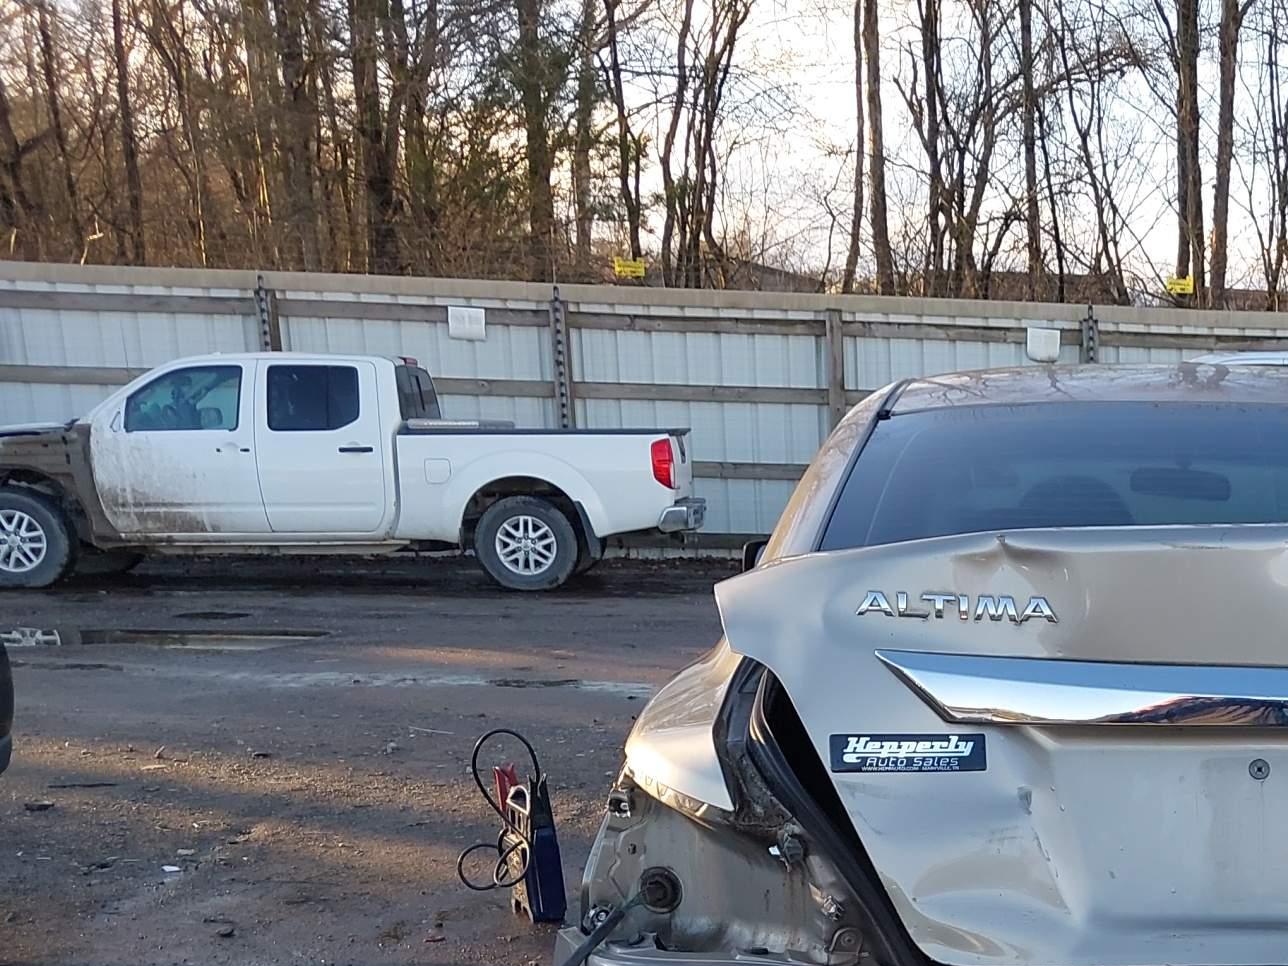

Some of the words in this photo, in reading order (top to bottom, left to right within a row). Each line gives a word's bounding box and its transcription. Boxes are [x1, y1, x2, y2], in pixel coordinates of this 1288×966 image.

[856, 590, 1058, 624] ALTIMA
[843, 735, 974, 763] Hepperly
[866, 756, 908, 767] Auto
[913, 755, 959, 767] Sales
